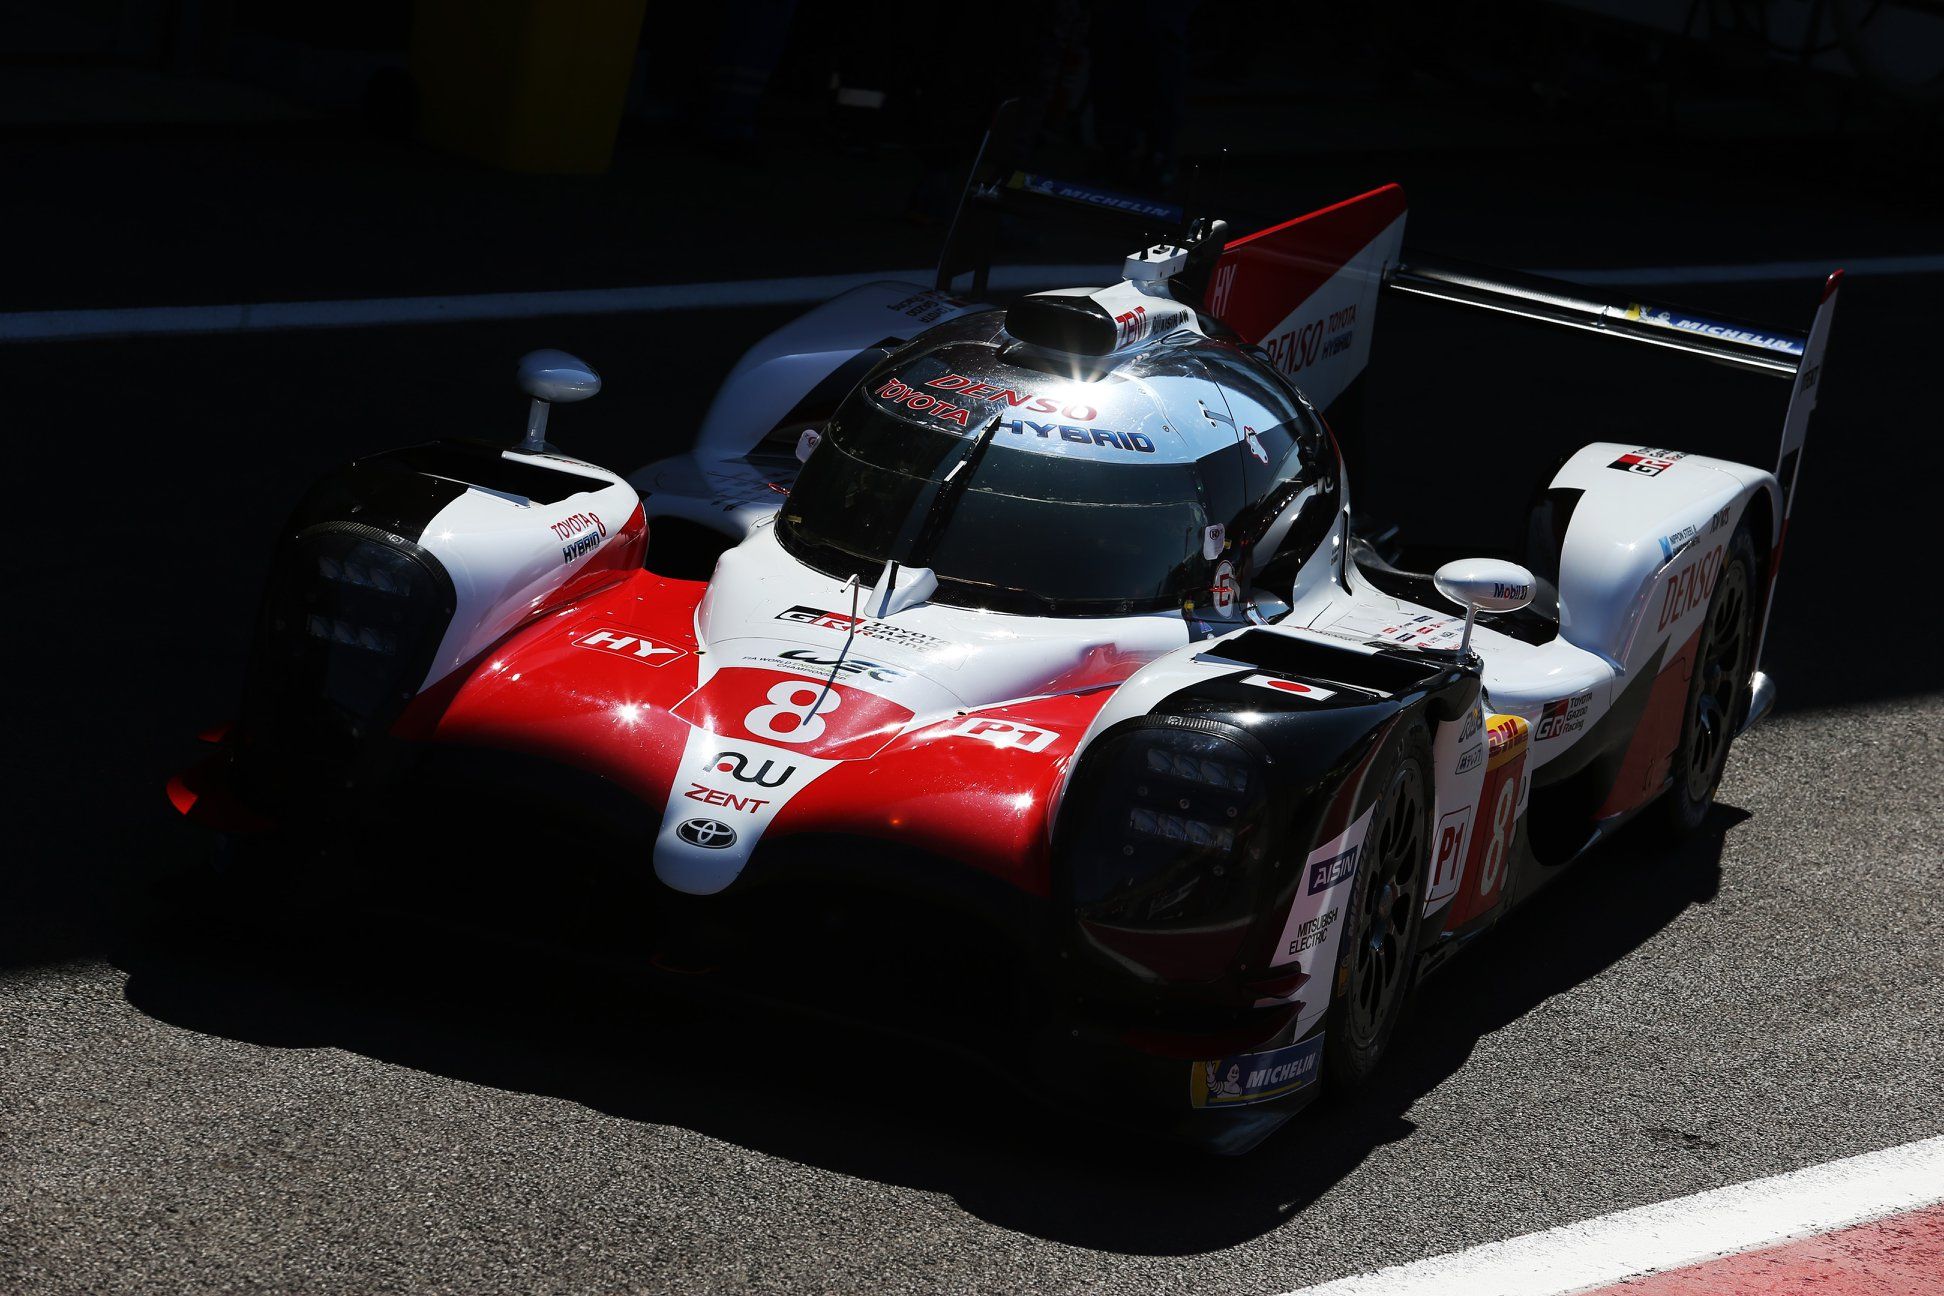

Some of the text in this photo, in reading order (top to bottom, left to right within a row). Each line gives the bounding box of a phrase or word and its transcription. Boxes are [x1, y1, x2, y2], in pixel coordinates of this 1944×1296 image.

[1058, 188, 1172, 217] MICHELIN
[1212, 263, 1241, 318] HY
[1328, 304, 1357, 333] TOYOTA
[1676, 319, 1795, 349] MICHELIN
[875, 377, 971, 427] TOYOTA
[924, 373, 1098, 422] DENSO
[999, 419, 1157, 454] HYBRID
[550, 513, 592, 542] TOYOTA
[562, 531, 601, 564] HYBRID
[1493, 582, 1521, 600] Mobil
[1657, 545, 1723, 633] DENSO
[581, 631, 681, 658] HY
[764, 657, 796, 667] WORLD
[743, 681, 842, 744] 8
[1570, 691, 1593, 709] TOYOTA
[967, 721, 1044, 746] P1
[1536, 714, 1565, 739] GR
[1562, 719, 1585, 734] Racing
[684, 782, 770, 814] ZENT
[1479, 776, 1515, 897] 8
[1312, 848, 1357, 889] AISIN
[1433, 821, 1465, 886] P1
[1289, 928, 1328, 955] ELECTRIC
[1245, 1052, 1317, 1089] MICHELIN
